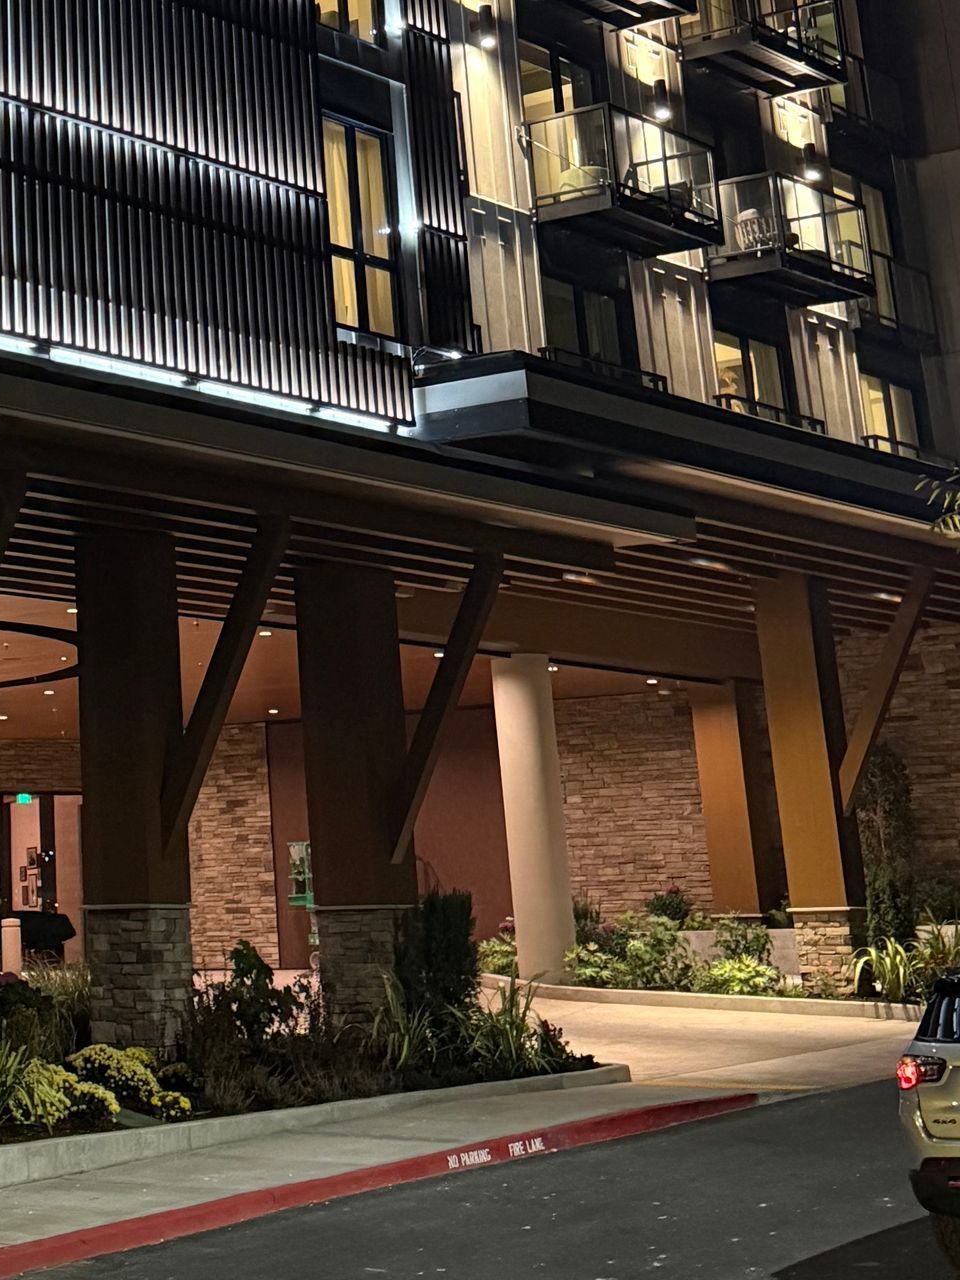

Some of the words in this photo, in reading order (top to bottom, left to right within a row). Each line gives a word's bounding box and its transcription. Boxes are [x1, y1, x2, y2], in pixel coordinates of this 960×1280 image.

[447, 1154, 460, 1169] NO
[460, 1148, 492, 1166] PARKING
[508, 1141, 526, 1157] FIRE
[526, 1137, 546, 1153] LANE
